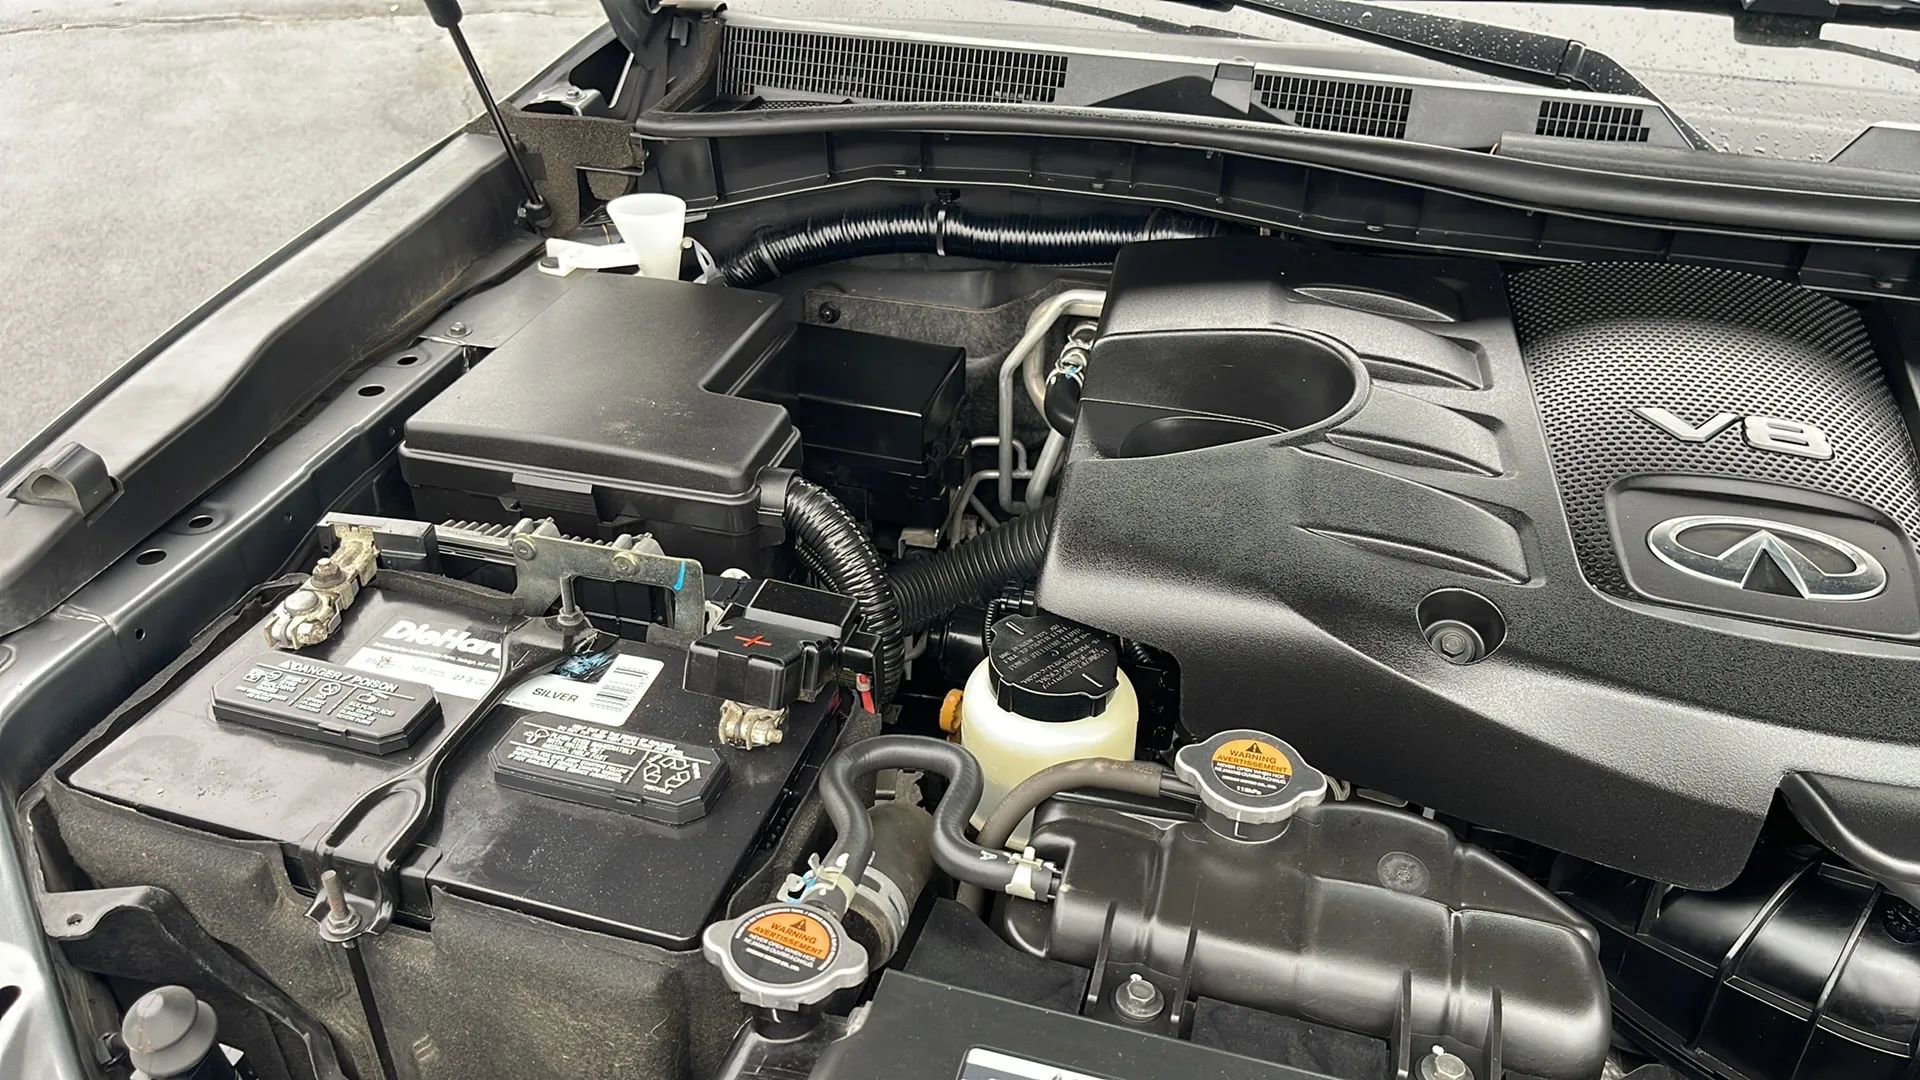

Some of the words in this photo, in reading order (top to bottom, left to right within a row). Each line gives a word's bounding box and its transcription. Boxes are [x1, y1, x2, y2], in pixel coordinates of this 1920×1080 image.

[1629, 407, 1836, 459] V8
[291, 661, 343, 680] DANGER
[351, 675, 399, 692] POISON
[532, 688, 579, 703] SILVER
[1217, 755, 1288, 773] AVERTISSEMENT
[1229, 749, 1277, 764] WARNING
[643, 783, 673, 795] RECYCLE
[754, 926, 824, 956] AVERTISSEMENT
[771, 922, 816, 944] WARNING
